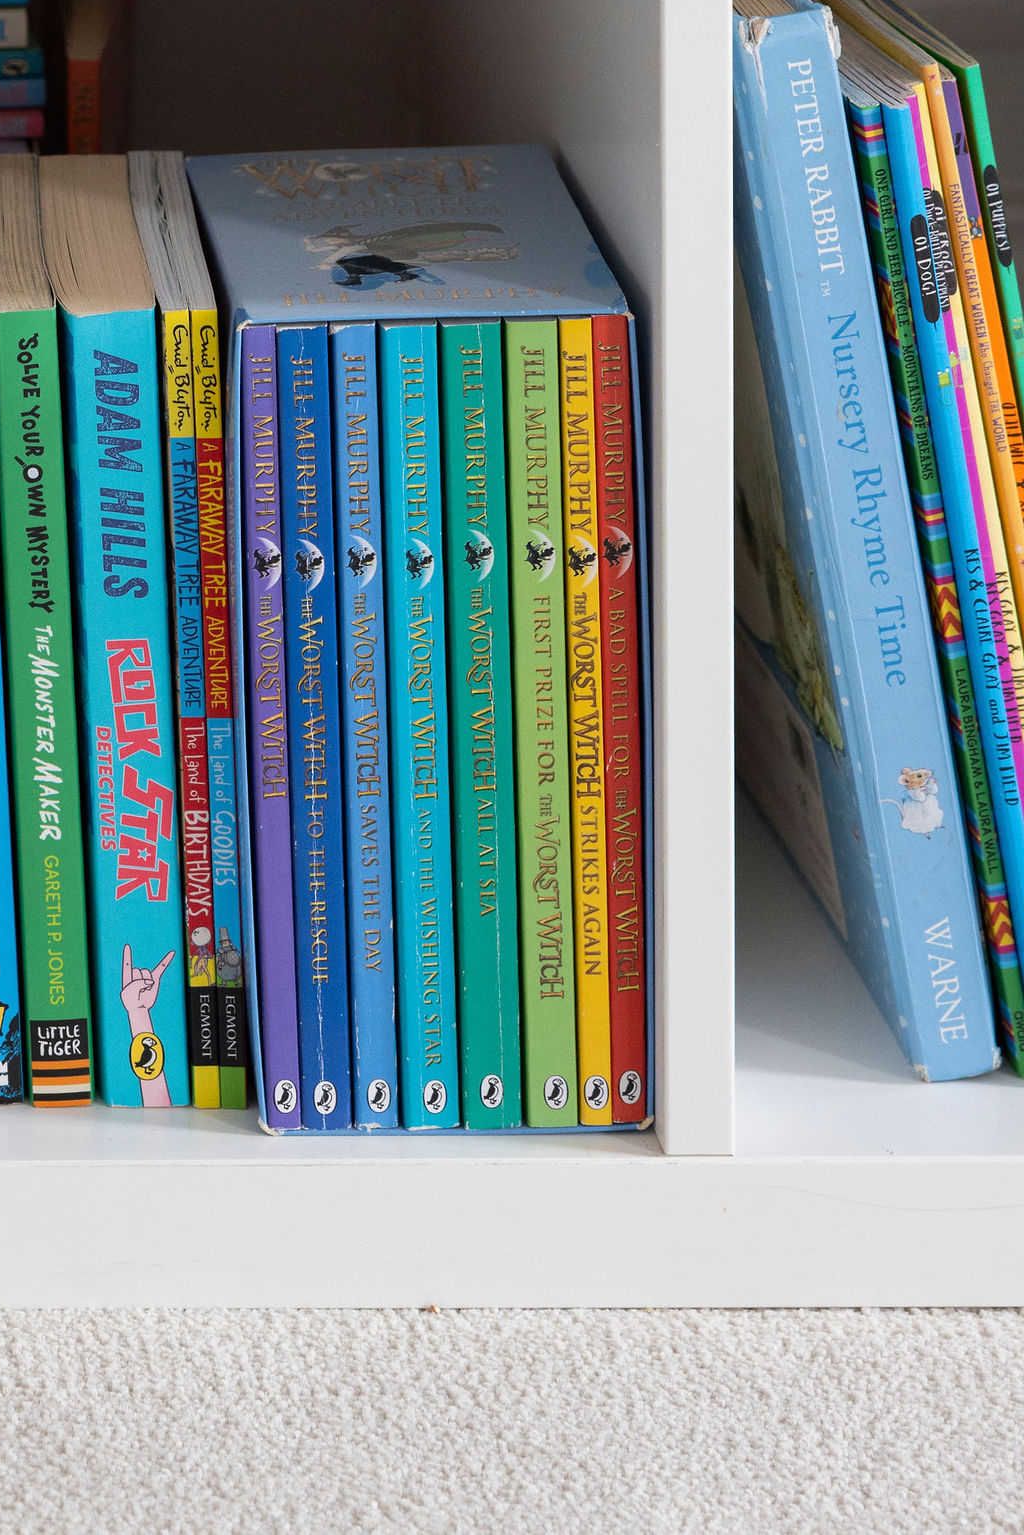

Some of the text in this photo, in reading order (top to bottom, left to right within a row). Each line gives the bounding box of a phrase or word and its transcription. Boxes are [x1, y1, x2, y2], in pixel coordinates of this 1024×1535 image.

[788, 59, 844, 273] PETER RABBIT
[93, 349, 150, 599] ADAM HILLS
[520, 346, 550, 530] JILL MURPHY
[826, 312, 905, 686] Nursery Rhyme Time
[531, 596, 564, 998] FIRST PRIZE FOR THE WORST WITCH
[42, 855, 64, 1004] GARETH P. JONES
[199, 994, 211, 1057] EGMONT
[925, 917, 967, 1042] WARNE
